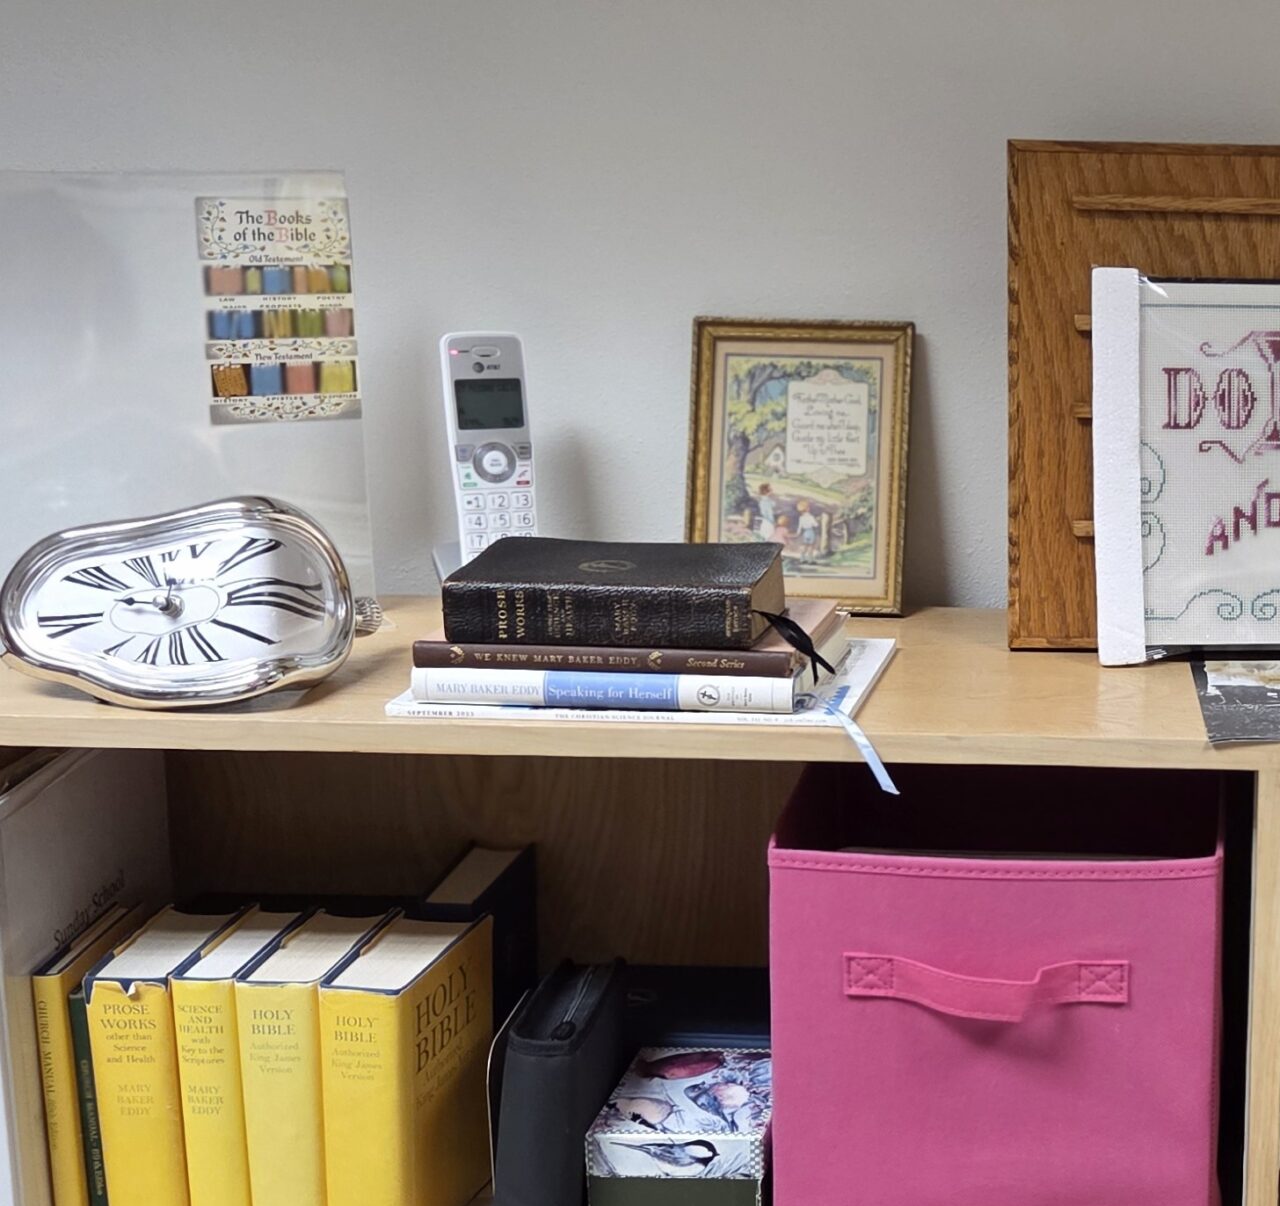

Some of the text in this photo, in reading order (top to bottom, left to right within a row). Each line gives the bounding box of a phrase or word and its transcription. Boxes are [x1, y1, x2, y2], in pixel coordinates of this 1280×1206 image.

[234, 210, 312, 225] The Books
[233, 227, 316, 242] of the Bible
[248, 255, 303, 263] Old Testament
[254, 352, 313, 361] New Testament
[1161, 367, 1256, 430] DO
[497, 590, 508, 639] PROSE
[516, 590, 526, 638] WORKS
[474, 653, 491, 661] WE
[497, 654, 528, 662] KNEW
[569, 655, 603, 664] BAKER
[686, 657, 717, 669] Second
[720, 658, 745, 669] Series
[436, 683, 672, 700] MARY BAKER EDDY Speaking for Herself
[415, 962, 472, 1037] HOLY
[103, 1004, 149, 1016] PROSE
[177, 1005, 222, 1014] SCIENCE
[253, 1009, 295, 1020] HOLY
[101, 1019, 157, 1030] WORKS
[188, 1016, 212, 1024] AND
[336, 1015, 375, 1028] HOLY
[179, 1024, 224, 1034] HEALTH
[251, 1024, 296, 1036] BIBLE
[416, 990, 478, 1074] BIBLE
[106, 1033, 152, 1041] other than
[191, 1036, 211, 1044] with
[334, 1030, 378, 1044] BIBLE
[106, 1055, 156, 1064] and Health
[181, 1056, 225, 1066] Scriptures
[117, 1084, 151, 1093] MARY
[188, 1085, 221, 1094] MARY
[117, 1096, 154, 1104] BAKER
[187, 1096, 224, 1105] BAKER
[120, 1107, 151, 1116] EDDY
[191, 1106, 222, 1115] EDDY
